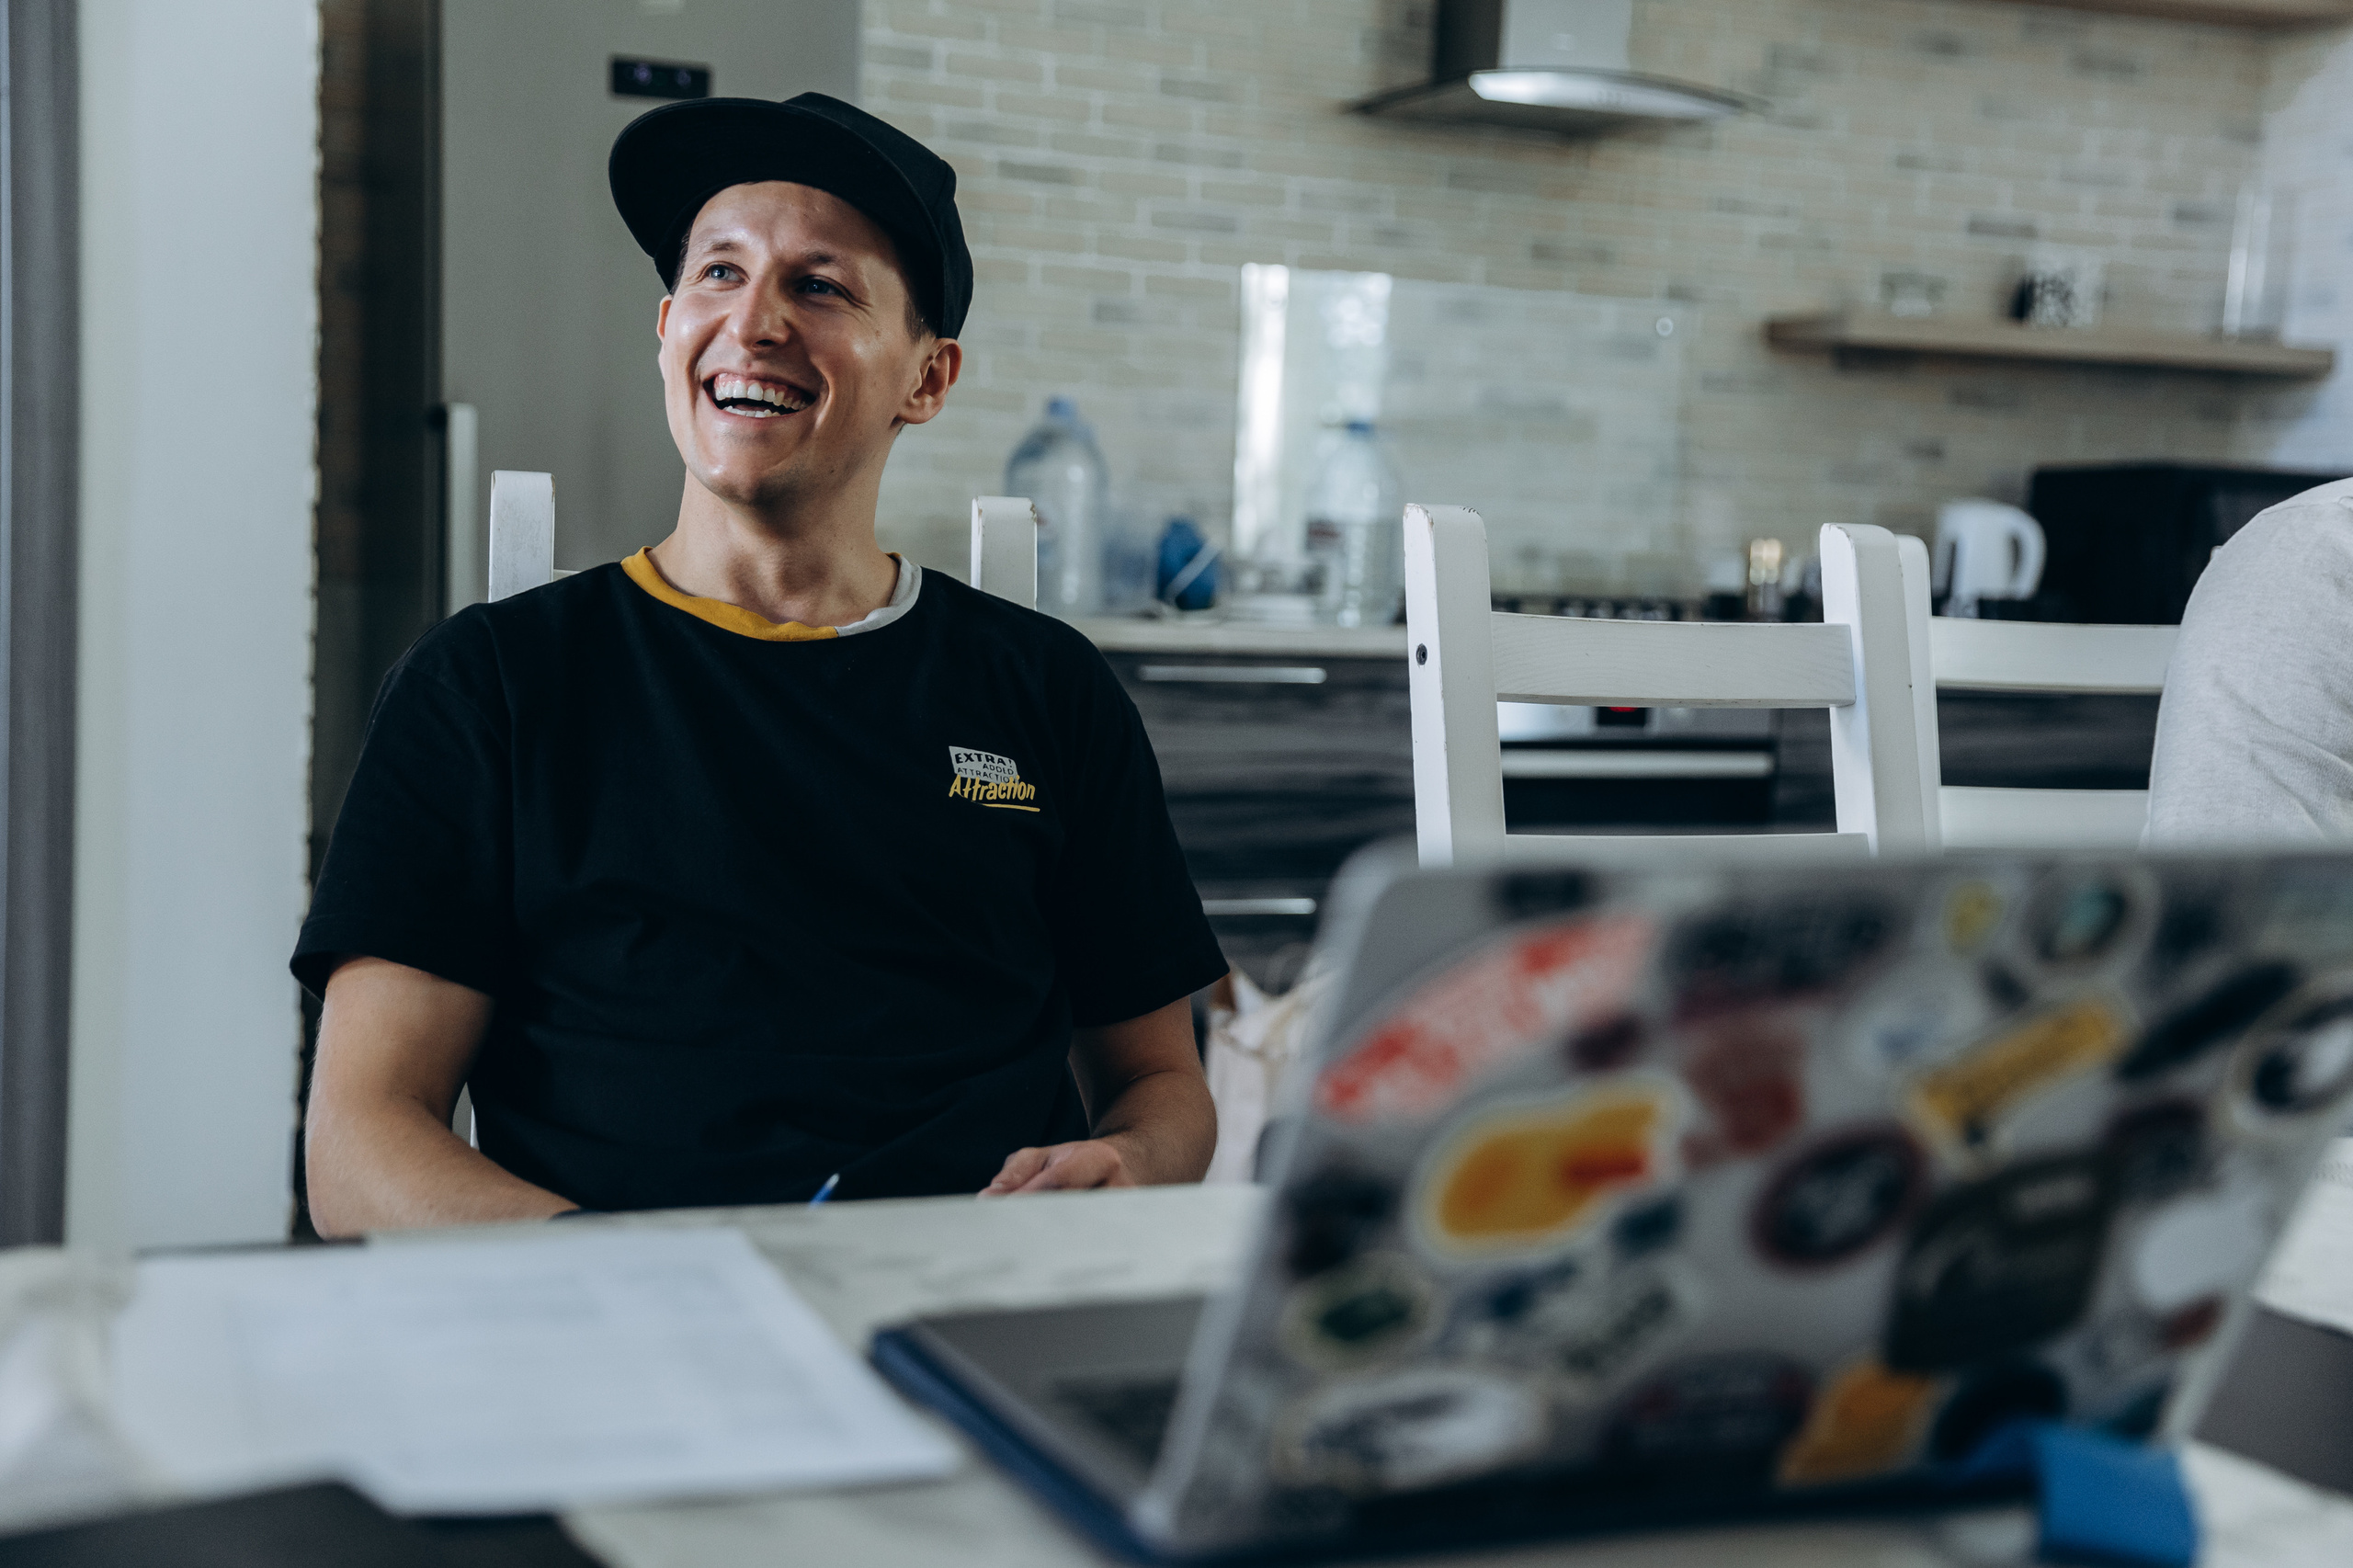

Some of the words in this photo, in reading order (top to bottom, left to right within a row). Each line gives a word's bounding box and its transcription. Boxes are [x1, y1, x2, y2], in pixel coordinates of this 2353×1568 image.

[955, 753, 1013, 768] EXTRA!
[983, 763, 1014, 775] ADDED
[949, 774, 1036, 801] Attraction
